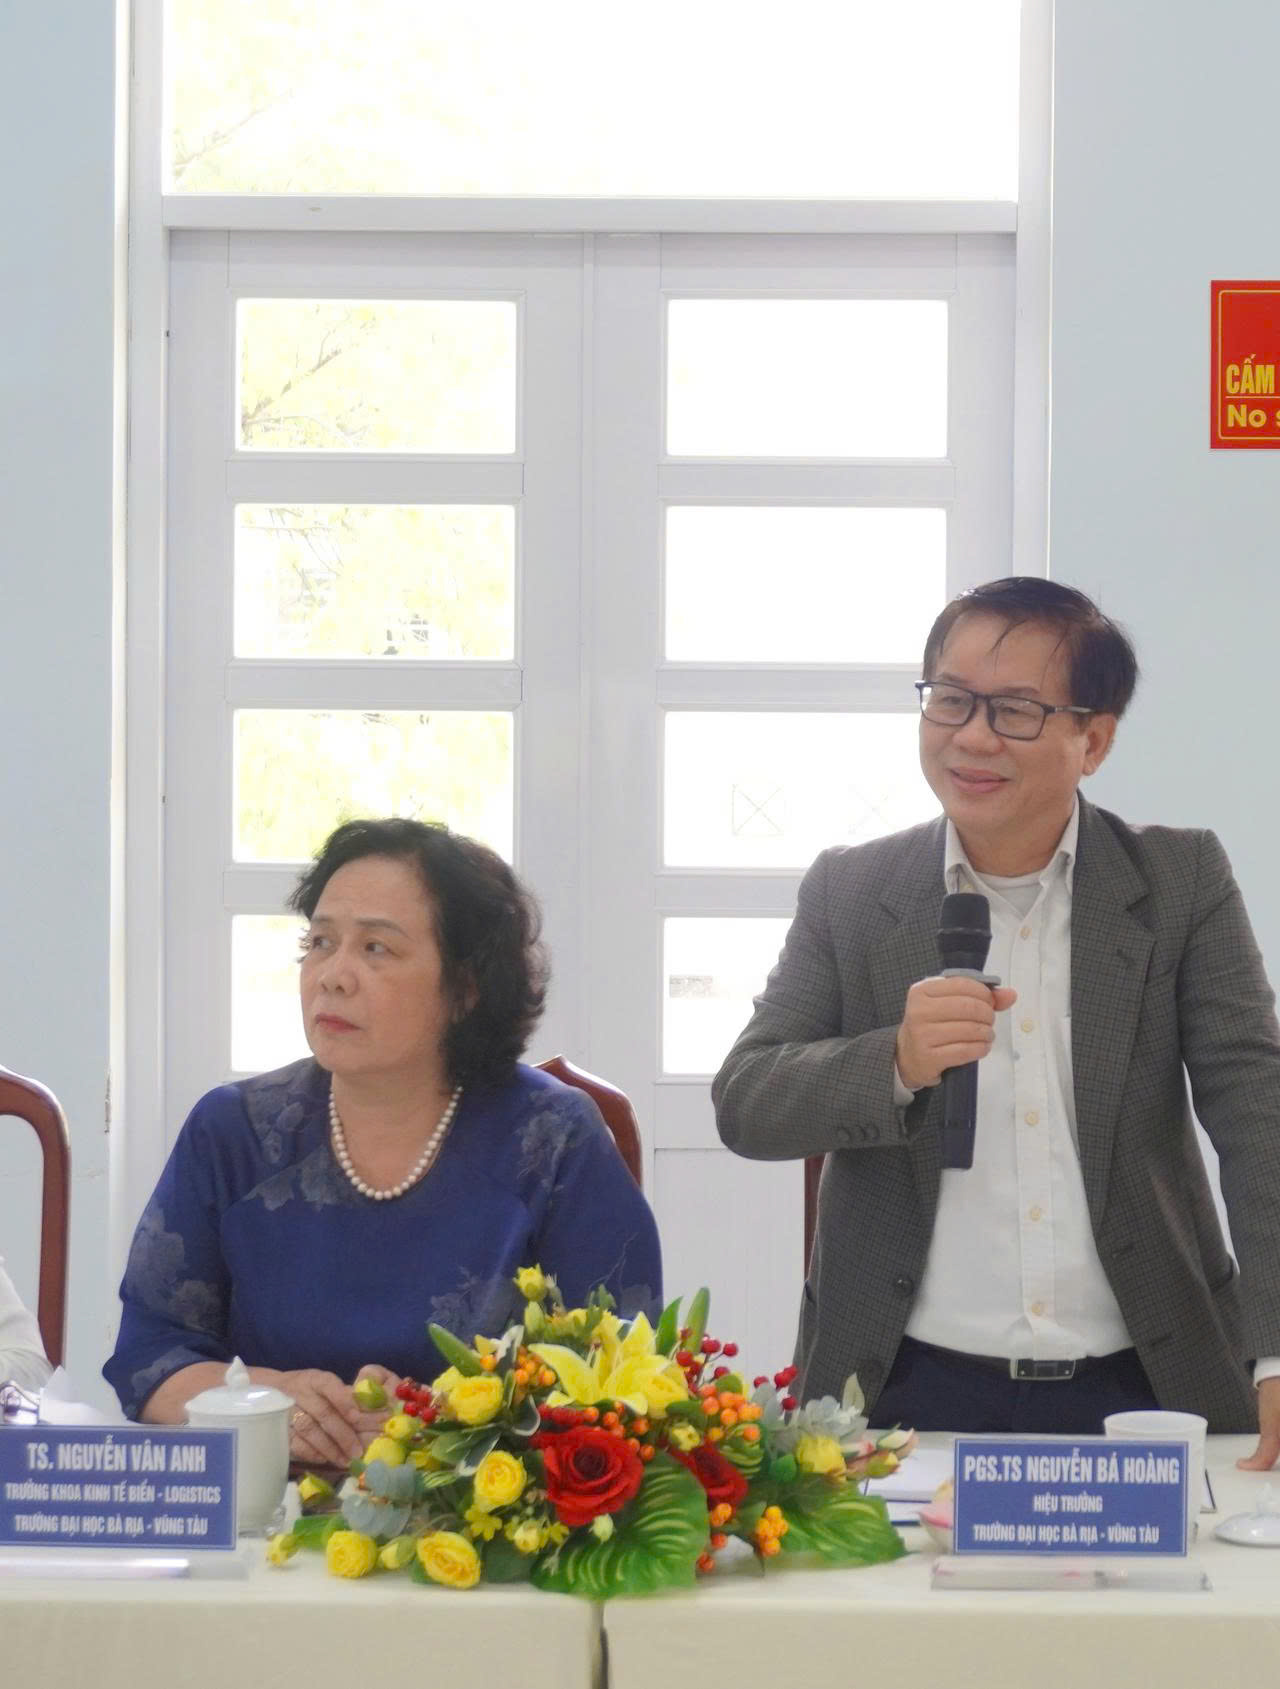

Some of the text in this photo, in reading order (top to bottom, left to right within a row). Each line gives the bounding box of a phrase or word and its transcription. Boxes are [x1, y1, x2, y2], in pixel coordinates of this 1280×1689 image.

[1226, 354, 1275, 394] CẤM
[1227, 404, 1267, 427] No
[27, 1434, 206, 1472] TS. NGUYỄN VÂN ANH
[964, 1447, 1180, 1484] PGS.TS NGUYỄN BÁ HOÀNG
[51, 1484, 81, 1501] KHOA
[84, 1484, 110, 1502] KINH
[114, 1480, 127, 1502] TẾ
[164, 1486, 221, 1504] LOGISTICS
[1034, 1492, 1058, 1515] HIỆU
[60, 1515, 80, 1536] ĐẠI
[82, 1516, 105, 1536] HỌC
[107, 1513, 122, 1534] BÀ
[124, 1516, 144, 1538] RỊA
[154, 1514, 184, 1535] VŨNG
[187, 1514, 208, 1535] TÀU
[1017, 1524, 1036, 1545] ĐẠI
[1039, 1525, 1060, 1545] HỌC
[1062, 1523, 1077, 1543] BÀ
[1079, 1525, 1098, 1546] RỊA
[1107, 1522, 1136, 1543] VŨNG
[1139, 1523, 1160, 1544] TÀU
